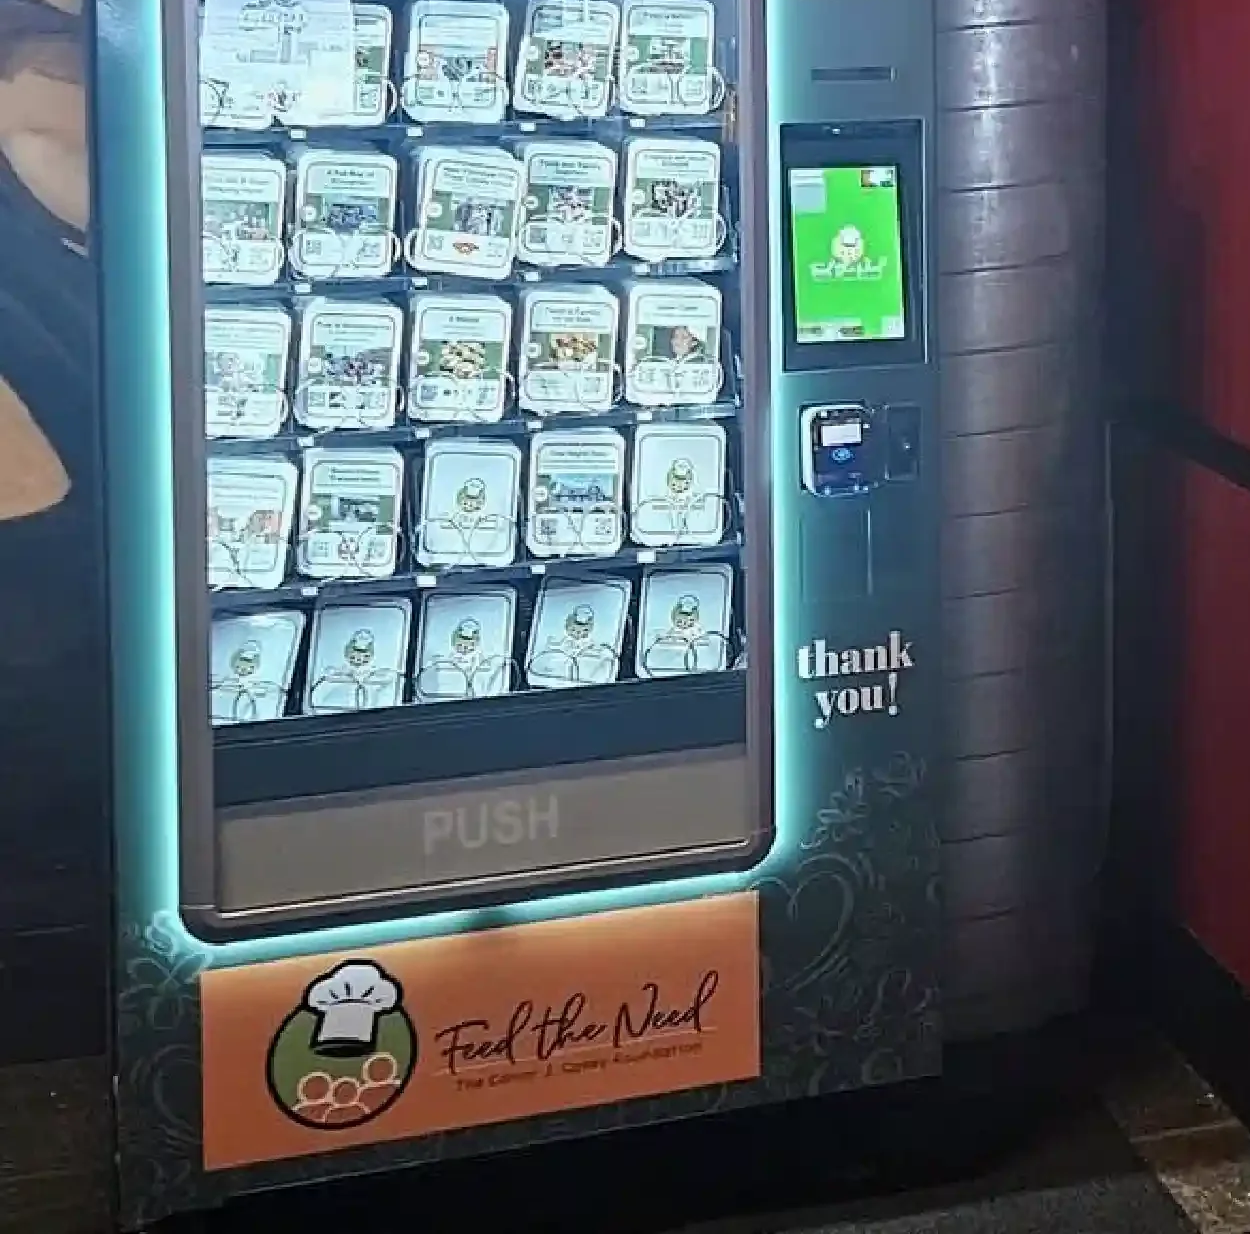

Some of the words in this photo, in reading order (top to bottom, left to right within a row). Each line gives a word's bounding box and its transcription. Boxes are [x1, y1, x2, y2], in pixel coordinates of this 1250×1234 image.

[797, 630, 914, 679] thank
[814, 671, 899, 729] you!
[424, 795, 559, 855] PUSH
[434, 1000, 534, 1075] Feed
[531, 992, 608, 1061] the
[612, 969, 719, 1049] Need
